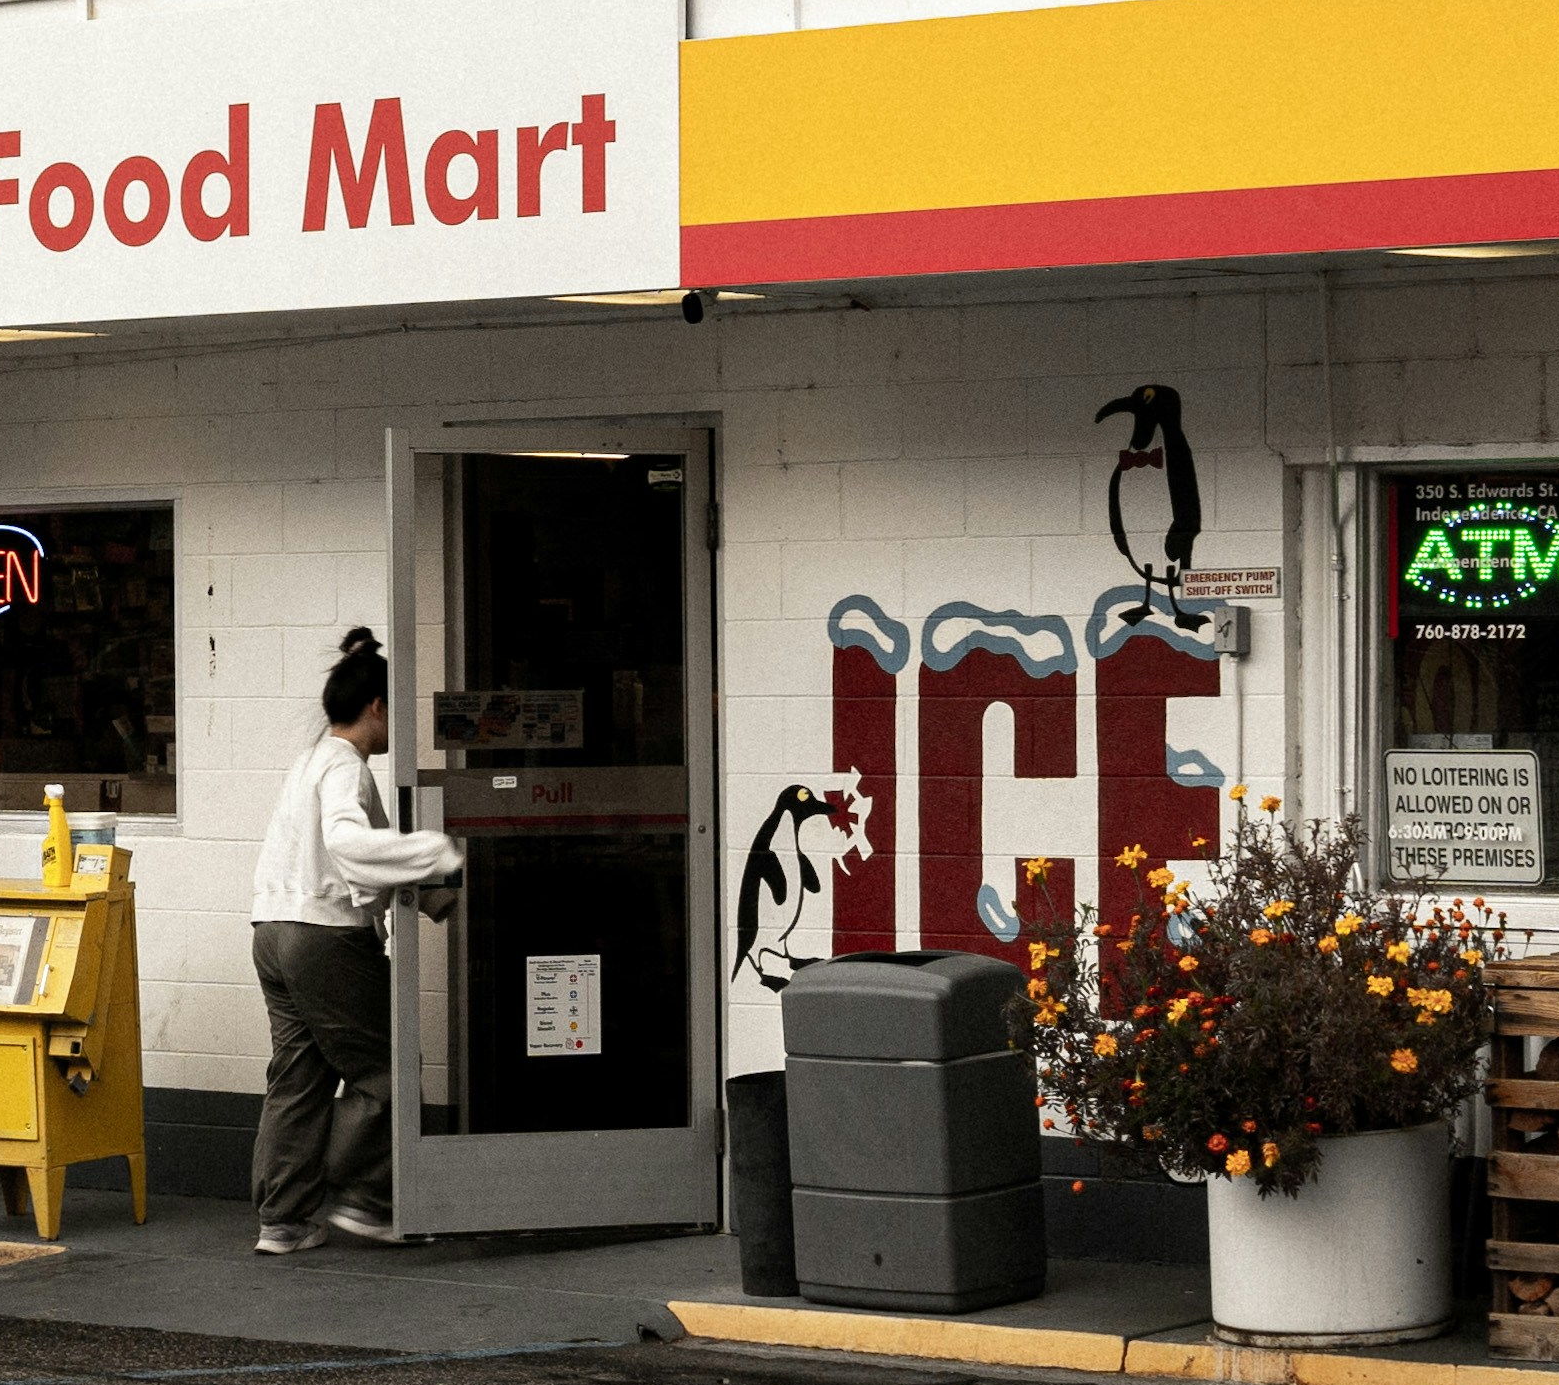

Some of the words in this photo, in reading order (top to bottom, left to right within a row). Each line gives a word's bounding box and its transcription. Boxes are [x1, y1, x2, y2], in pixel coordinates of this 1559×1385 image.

[302, 93, 616, 233] Mart
[1416, 485, 1444, 499] 350
[1449, 485, 1462, 499] S.
[1468, 483, 1534, 498] Edwards
[1539, 483, 1558, 497] St.
[1537, 505, 1558, 520] CA
[1184, 572, 1243, 583] EMERGENCY
[1246, 571, 1275, 582] PUMP
[1186, 585, 1232, 596] SHUT-OFF
[1235, 584, 1273, 595] SWITCH
[1416, 624, 1526, 640] 760-878-2172
[1393, 767, 1417, 785] NO
[1422, 768, 1509, 787] LOITERING
[1513, 768, 1529, 786] IS
[531, 782, 573, 805] Pull
[829, 600, 1224, 1020] ICE
[1395, 796, 1473, 814] ALLOWED
[1478, 796, 1502, 814] ON
[1507, 796, 1531, 814] OR
[1388, 824, 1447, 840] 6:30AM
[1464, 826, 1523, 842] 9:00PM
[1395, 846, 1448, 866] THESE
[1452, 848, 1535, 868] PREMISES
